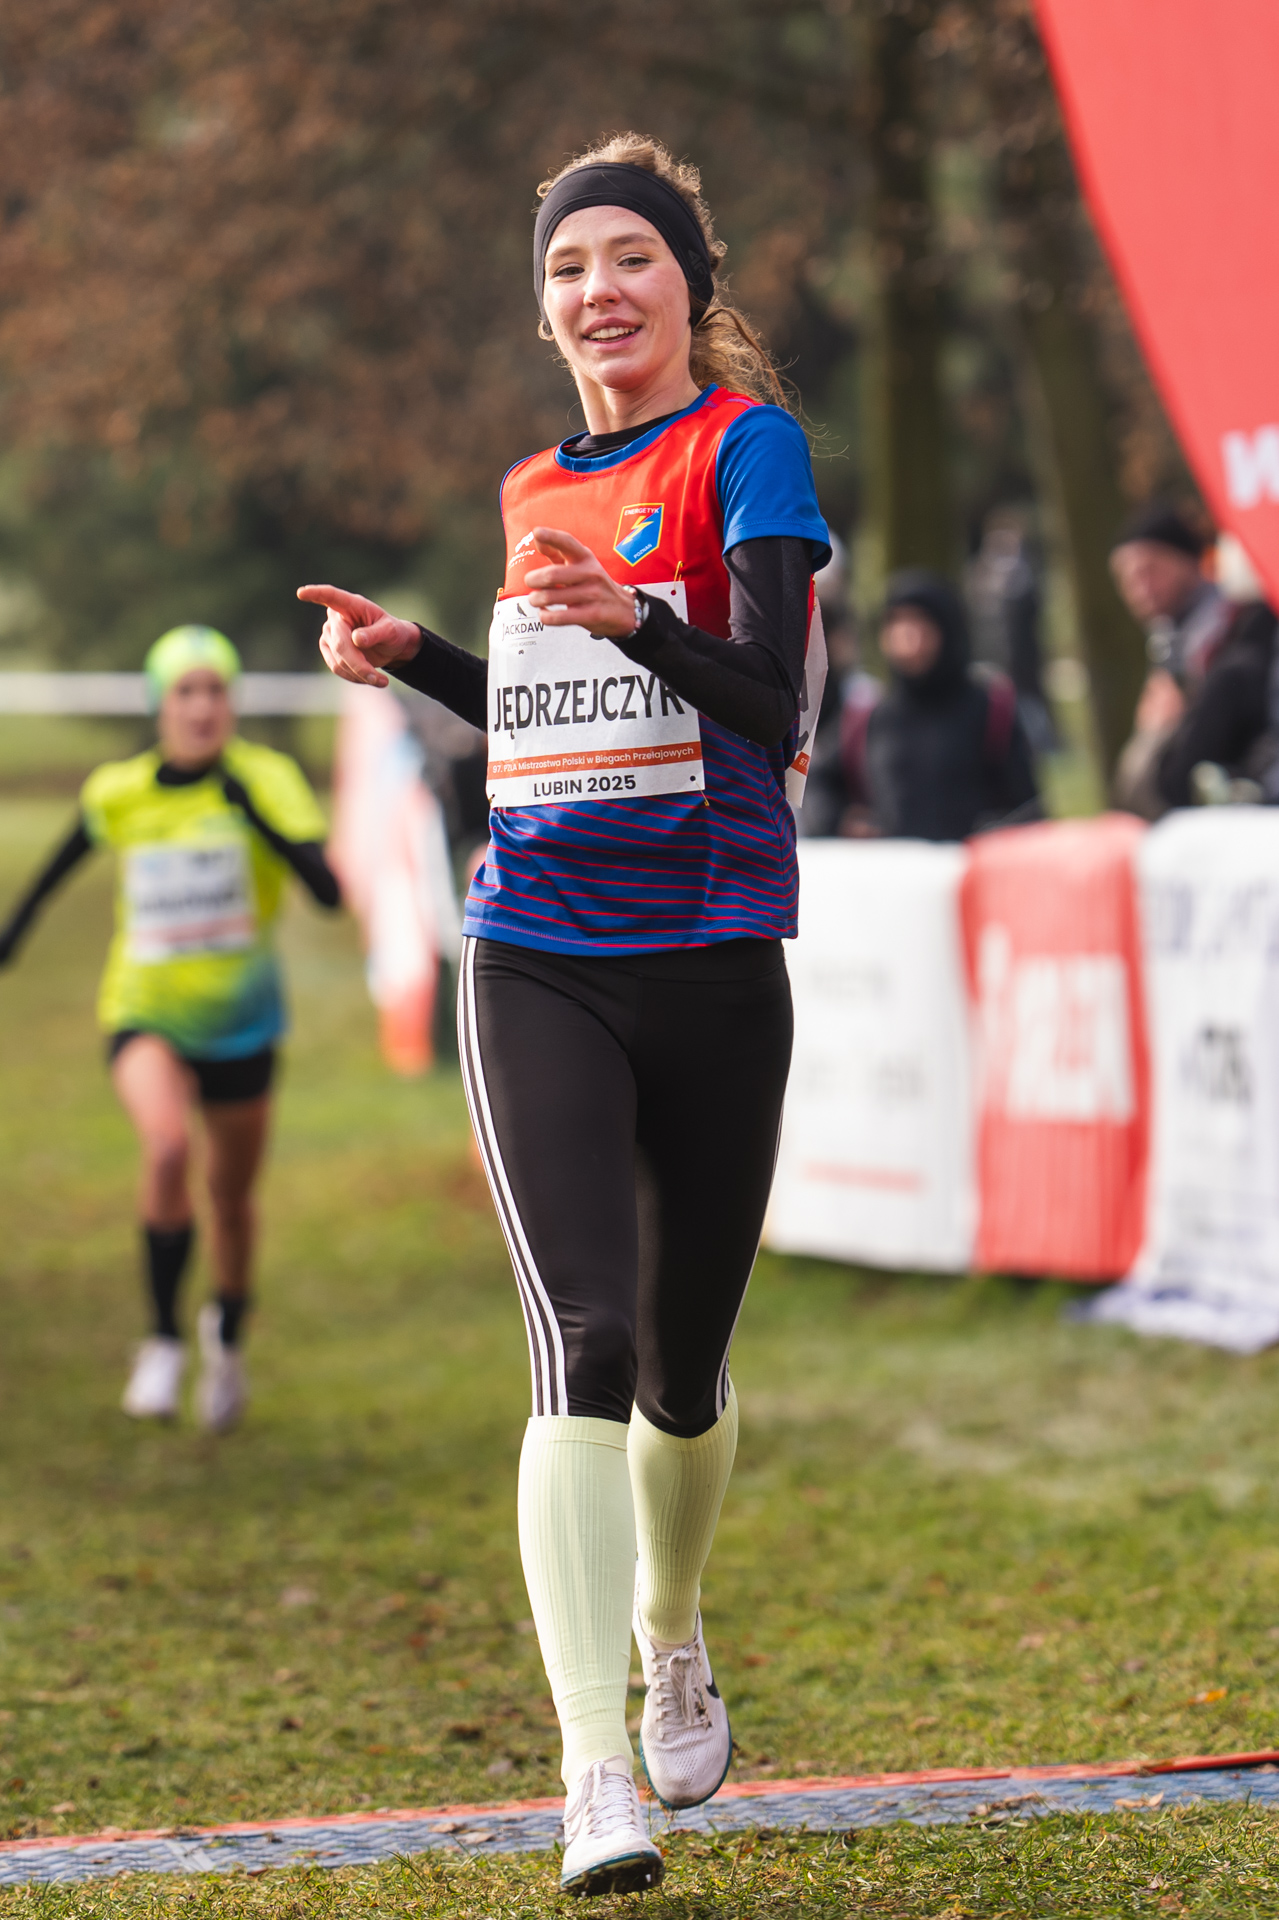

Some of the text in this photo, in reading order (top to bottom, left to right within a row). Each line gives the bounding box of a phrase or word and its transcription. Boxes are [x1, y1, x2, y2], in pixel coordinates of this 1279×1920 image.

[624, 507, 660, 516] ENERGETYK
[502, 621, 545, 641] JACKDAW
[492, 765, 503, 774] 97.
[503, 763, 517, 773] PZLA
[518, 759, 561, 771] Mistrzostwa
[562, 755, 585, 766] Polski
[595, 752, 631, 765] Biegach
[632, 746, 694, 760] Przełajowych
[533, 774, 636, 798] LUBIN 2025
